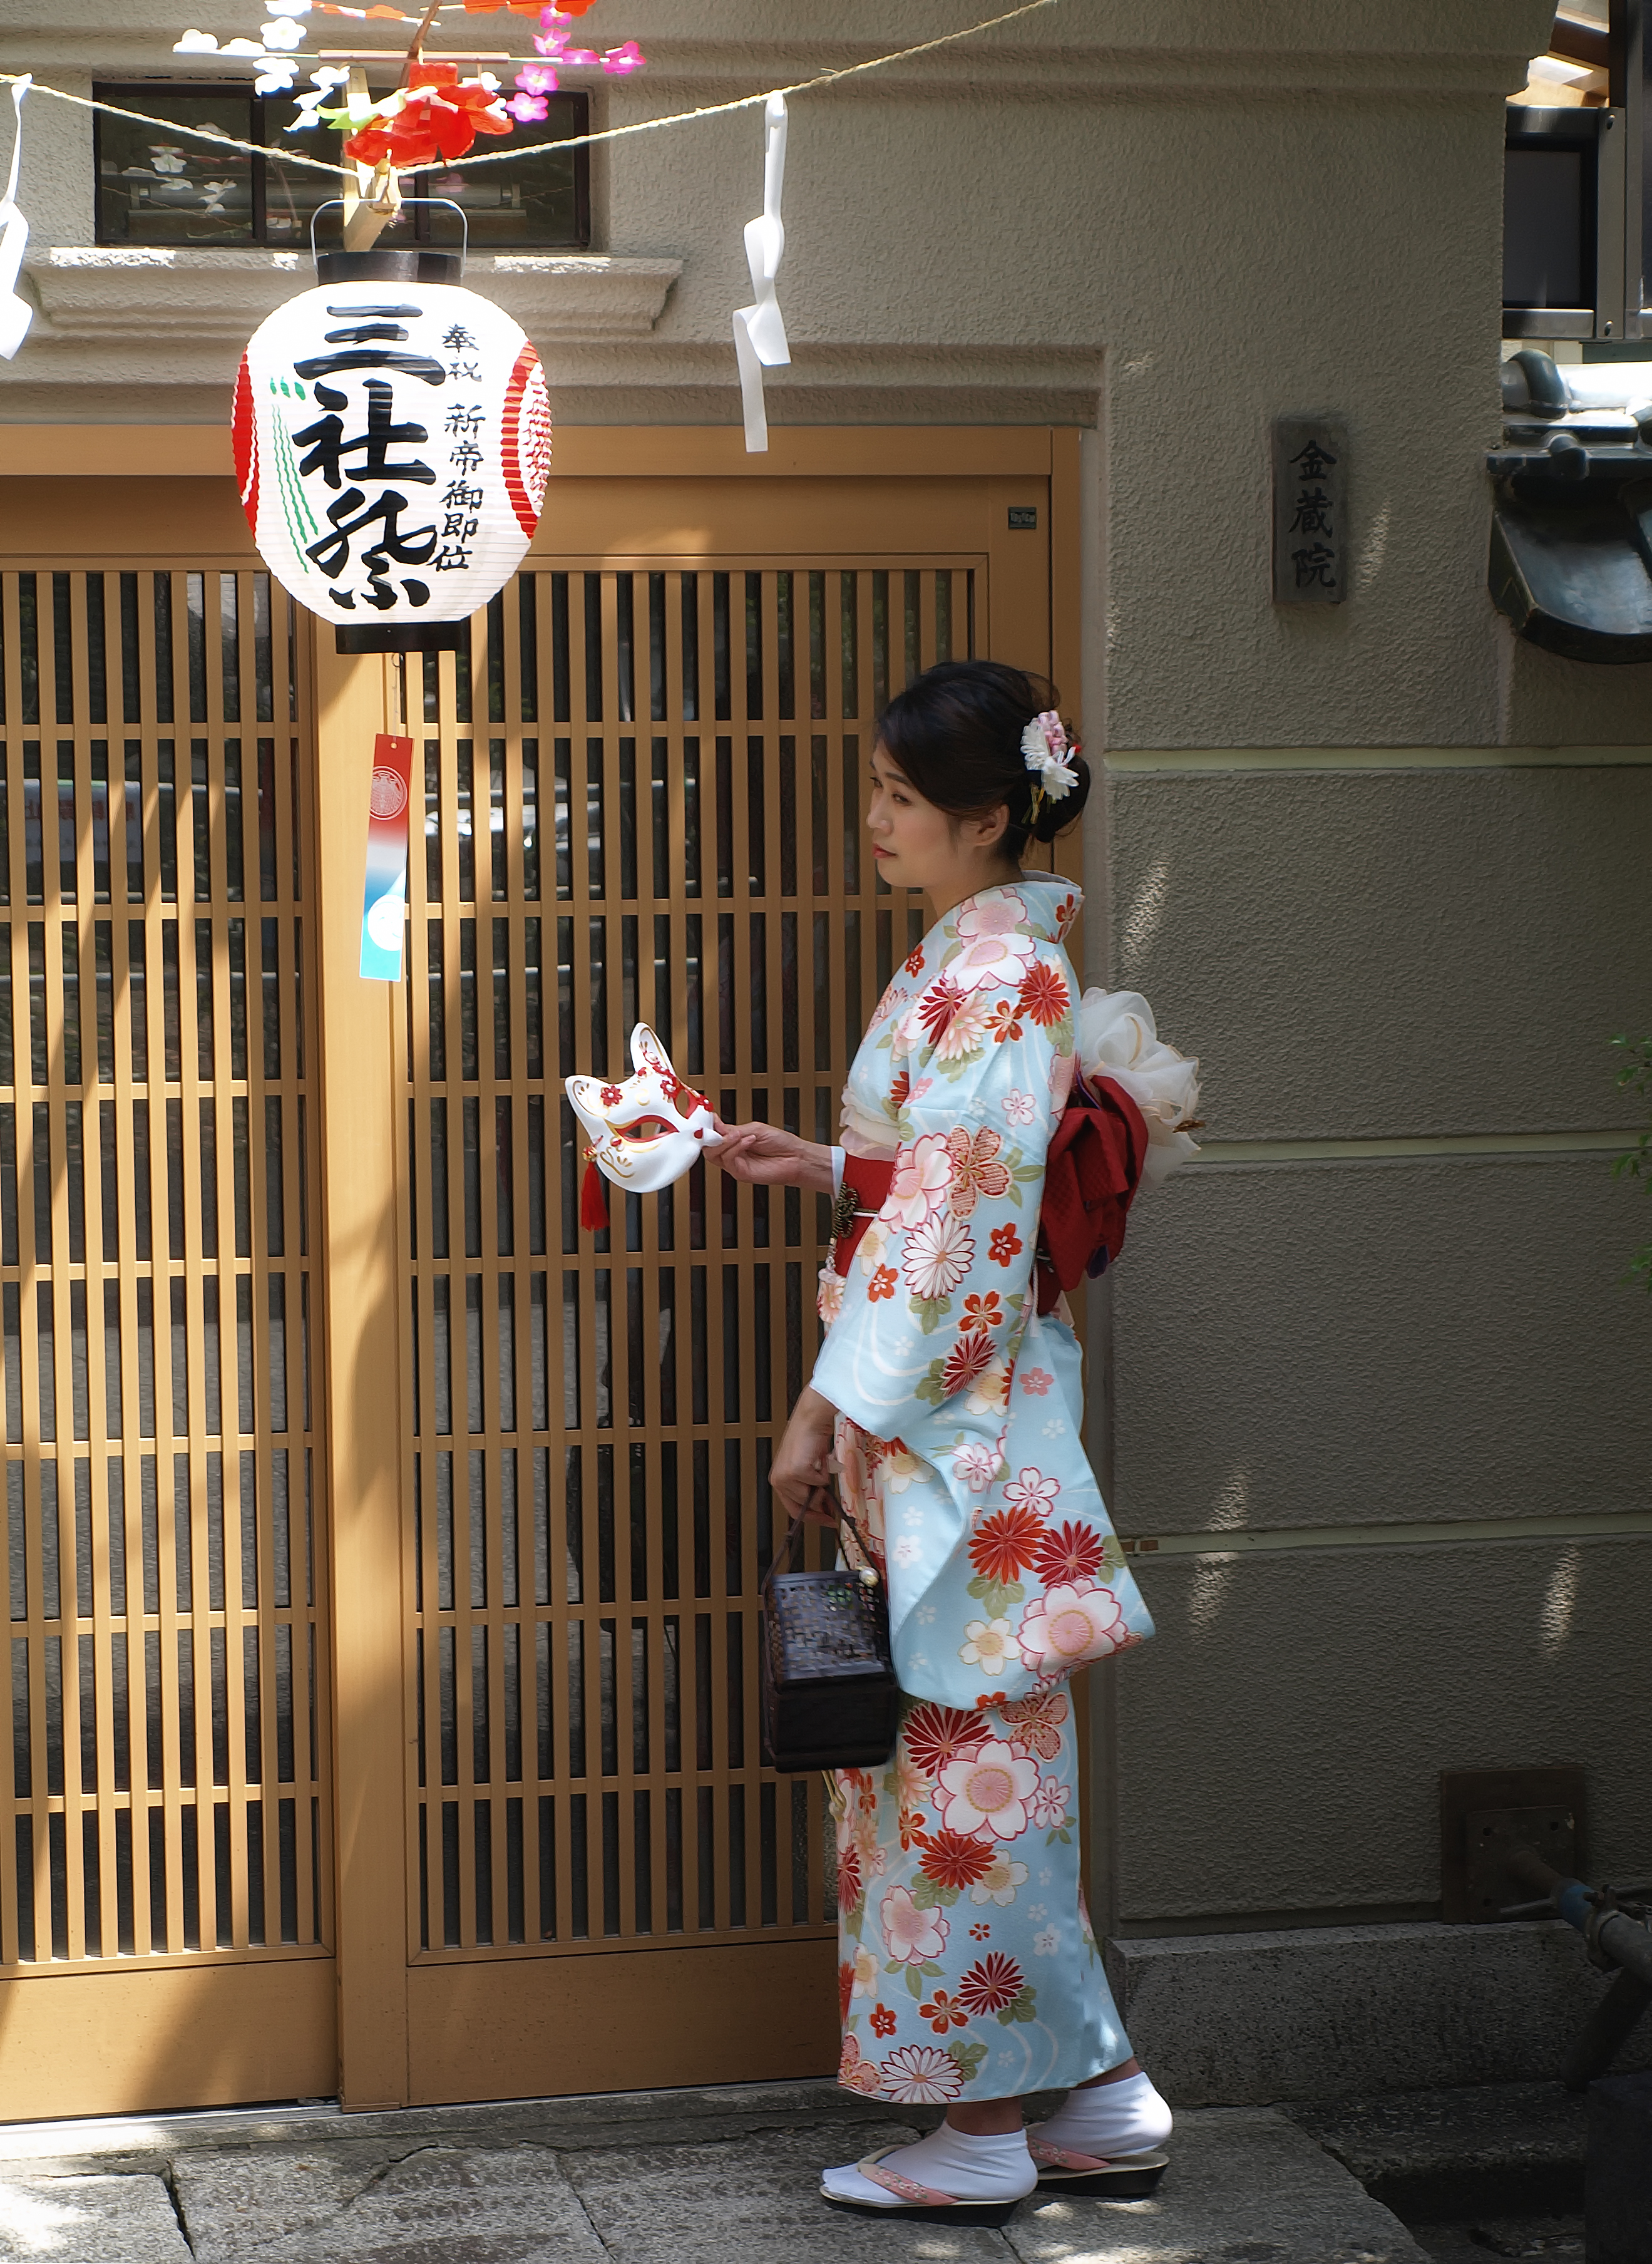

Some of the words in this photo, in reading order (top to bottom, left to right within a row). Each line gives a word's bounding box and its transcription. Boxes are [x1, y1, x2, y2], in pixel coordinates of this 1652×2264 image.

[441, 323, 482, 382] 奉祝
[292, 304, 446, 610] 三社祭
[426, 403, 486, 572] 新帝御即位
[1289, 440, 1337, 589] 金蔵院
